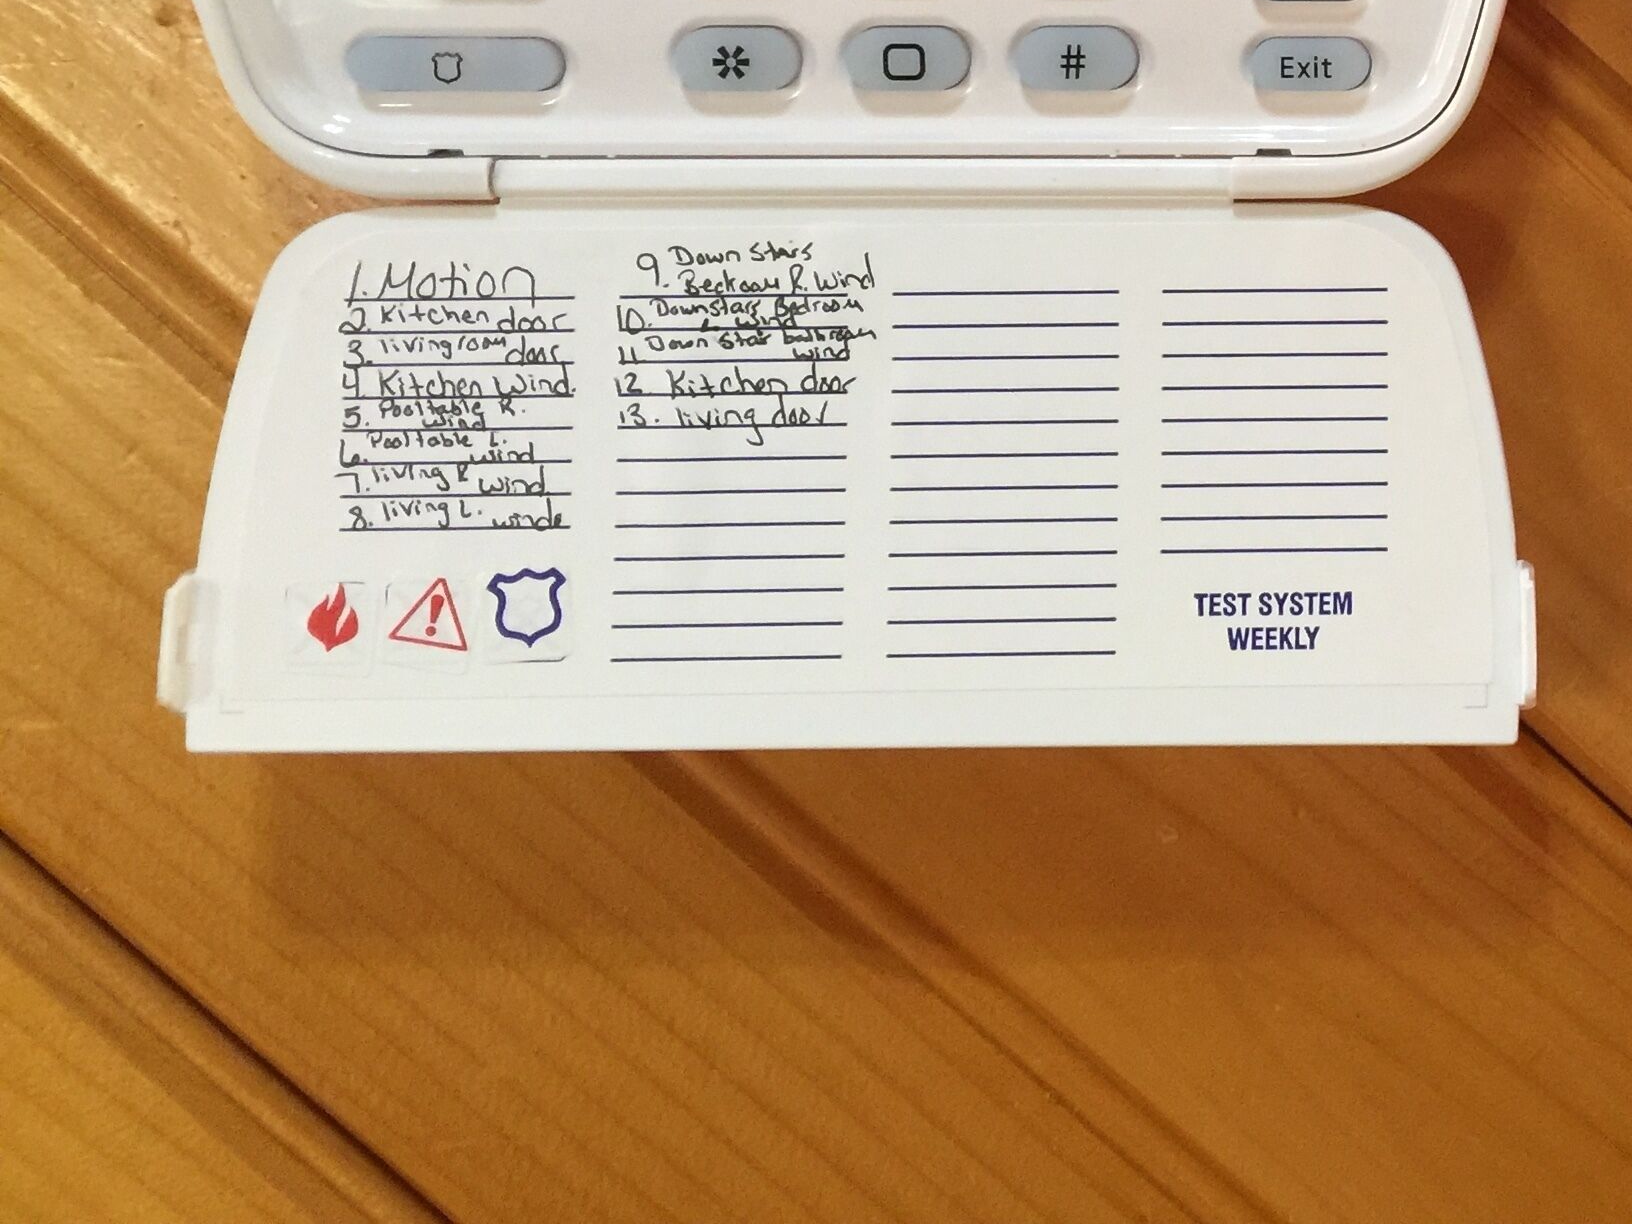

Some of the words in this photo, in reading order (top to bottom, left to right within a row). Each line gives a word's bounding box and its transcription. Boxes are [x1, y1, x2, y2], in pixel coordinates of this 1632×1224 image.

[1280, 56, 1332, 80] Exit
[667, 245, 741, 266] Down
[377, 260, 534, 308] Motion
[497, 305, 567, 333] door
[505, 335, 560, 366] door
[378, 369, 483, 398] Kitchen
[666, 366, 788, 400] Kitchen
[800, 359, 857, 395] door
[675, 408, 764, 446] living
[1194, 592, 1252, 616] TEST
[1258, 591, 1353, 616] SYSTEM
[1227, 626, 1320, 651] WEEKLY
